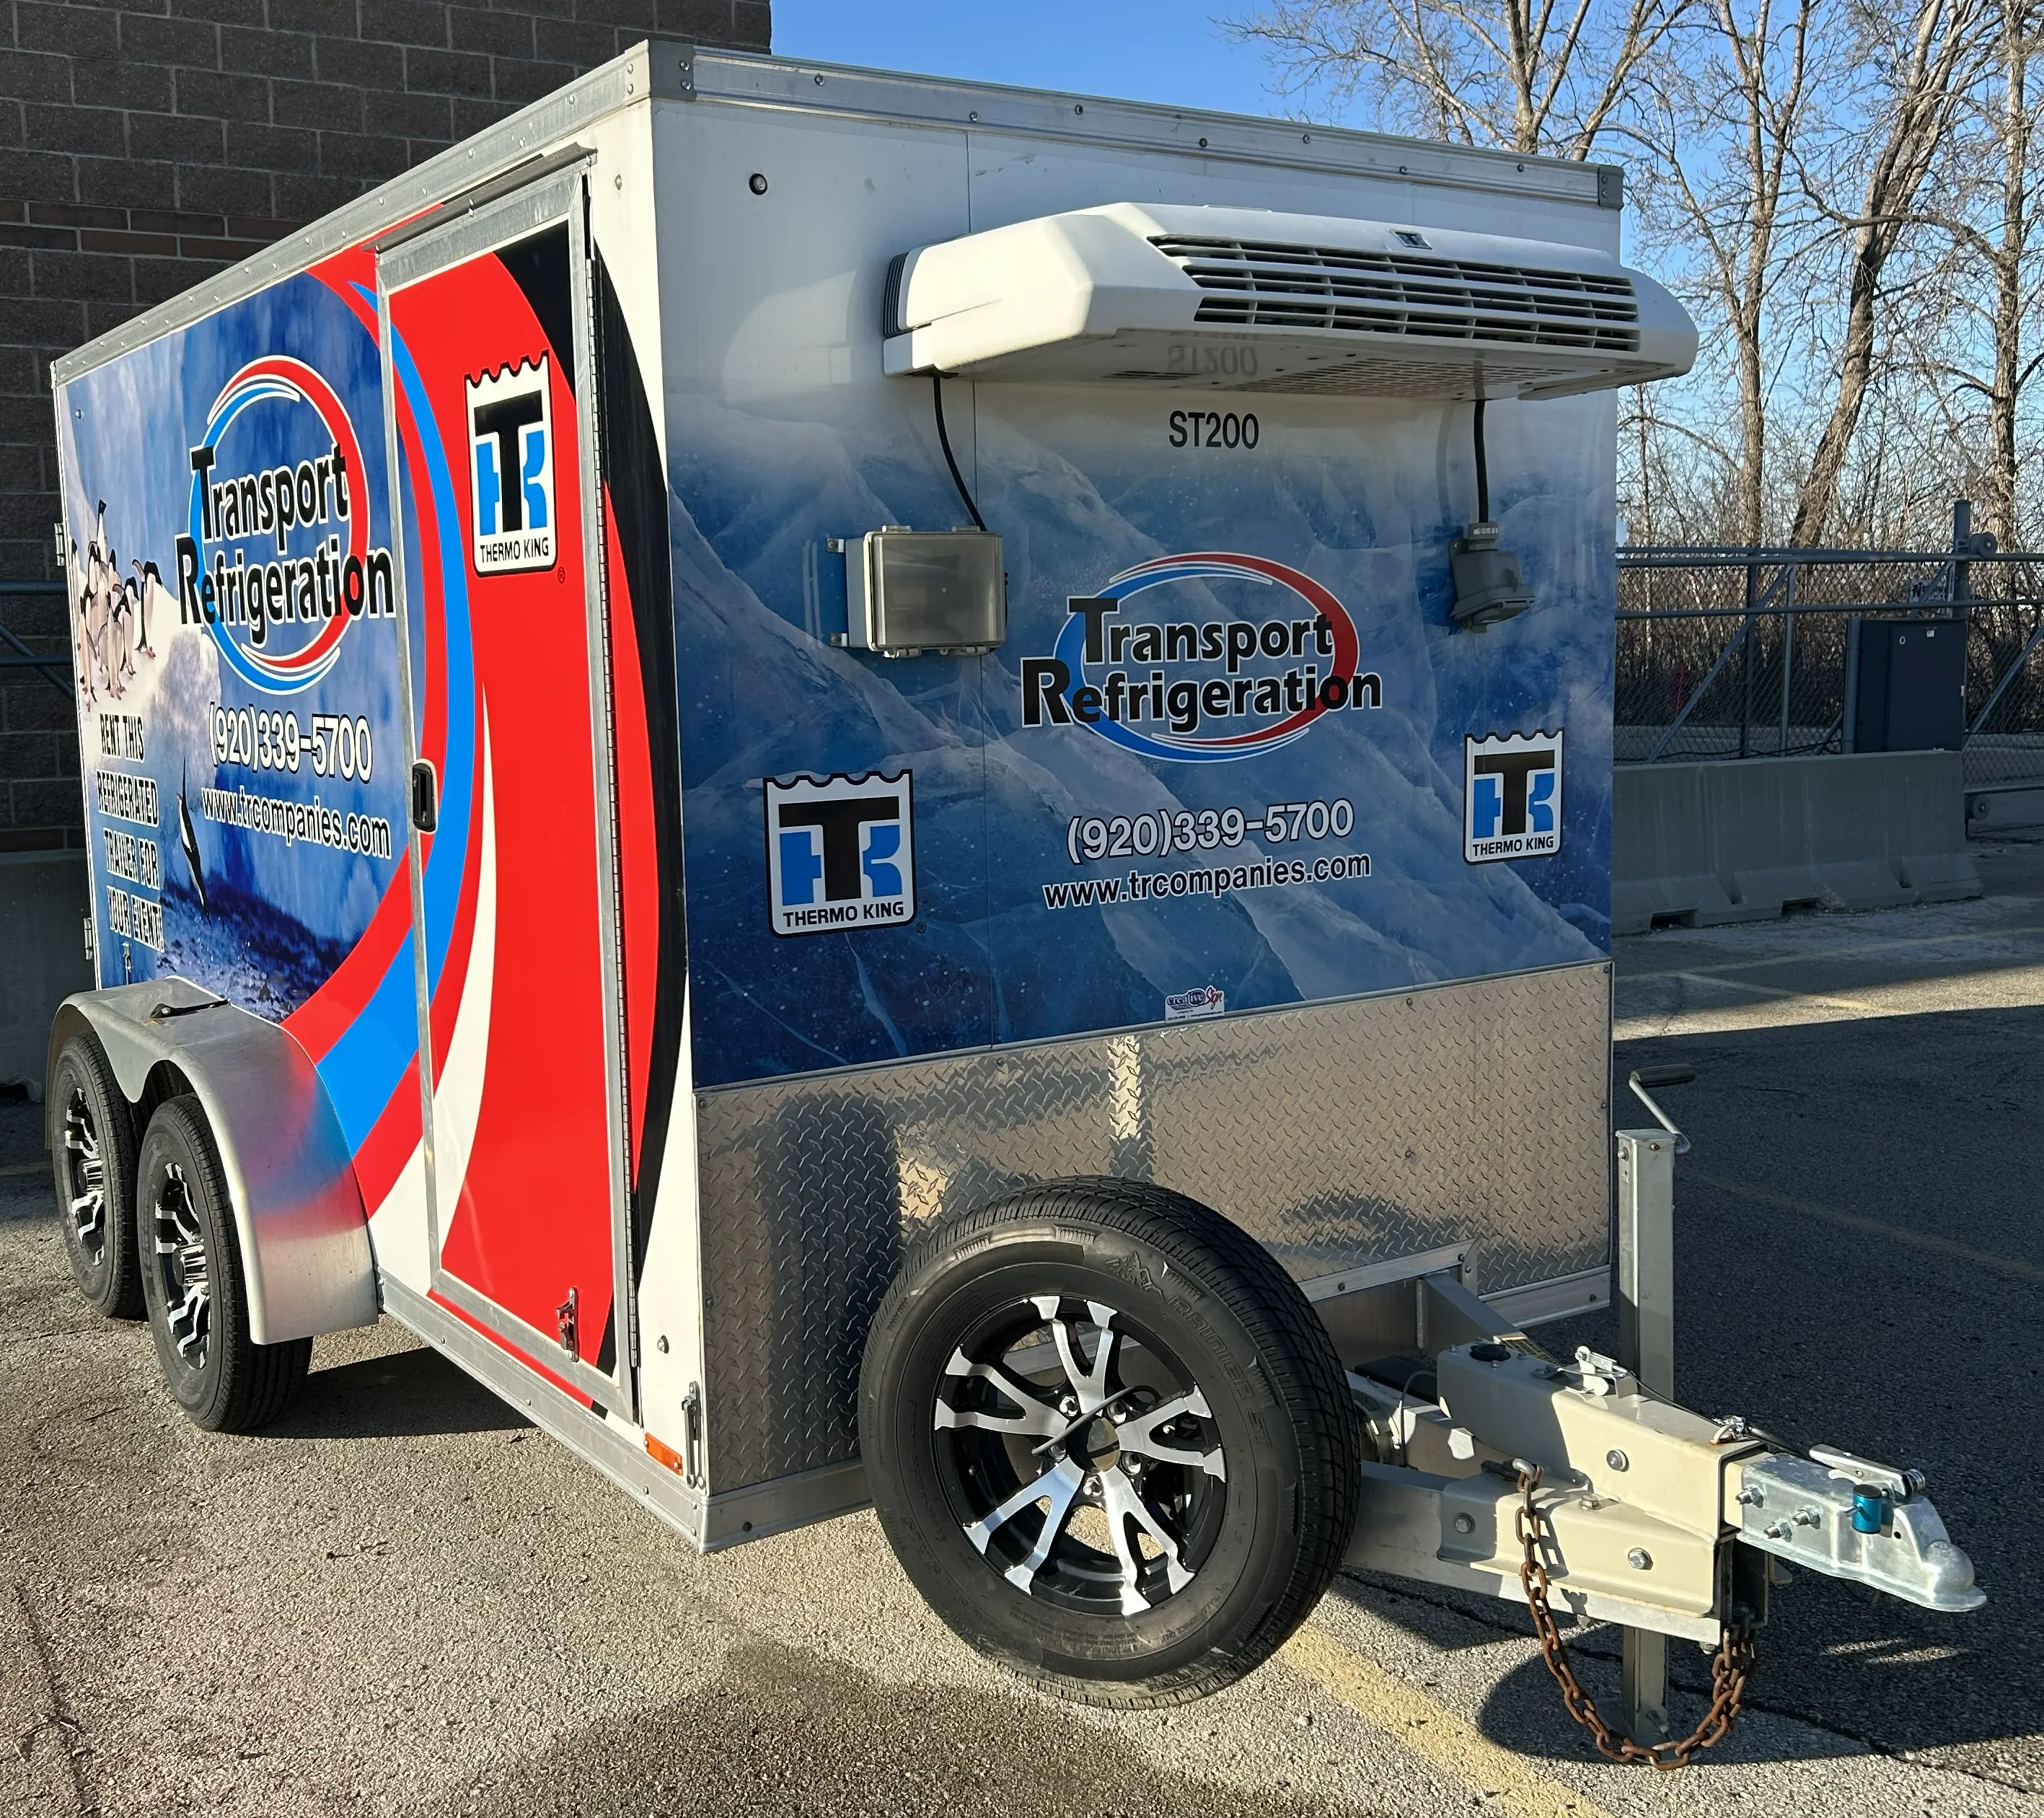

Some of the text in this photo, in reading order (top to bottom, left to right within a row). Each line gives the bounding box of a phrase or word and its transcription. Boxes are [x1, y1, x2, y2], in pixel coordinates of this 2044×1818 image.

[1168, 410, 1259, 449] ST200
[190, 442, 350, 555] Transport
[480, 536, 549, 563] THERMO KING
[175, 535, 396, 645] Refrigeration
[1067, 596, 1334, 675] Transport
[1021, 664, 1382, 734] Refrigeration
[100, 713, 144, 762] RENT THIS
[209, 701, 373, 784] (920)339-5700
[97, 770, 159, 827] REFRIGERATED
[202, 786, 392, 859] www.trcompanies.com
[103, 827, 160, 890] TRAILER FOR
[1067, 798, 1354, 864] (920)339-5700
[1473, 835, 1554, 856] THERMO KING
[1043, 851, 1372, 910] www.trcompanies.com
[107, 885, 132, 939] YOUR
[783, 901, 904, 928] THERMO KING
